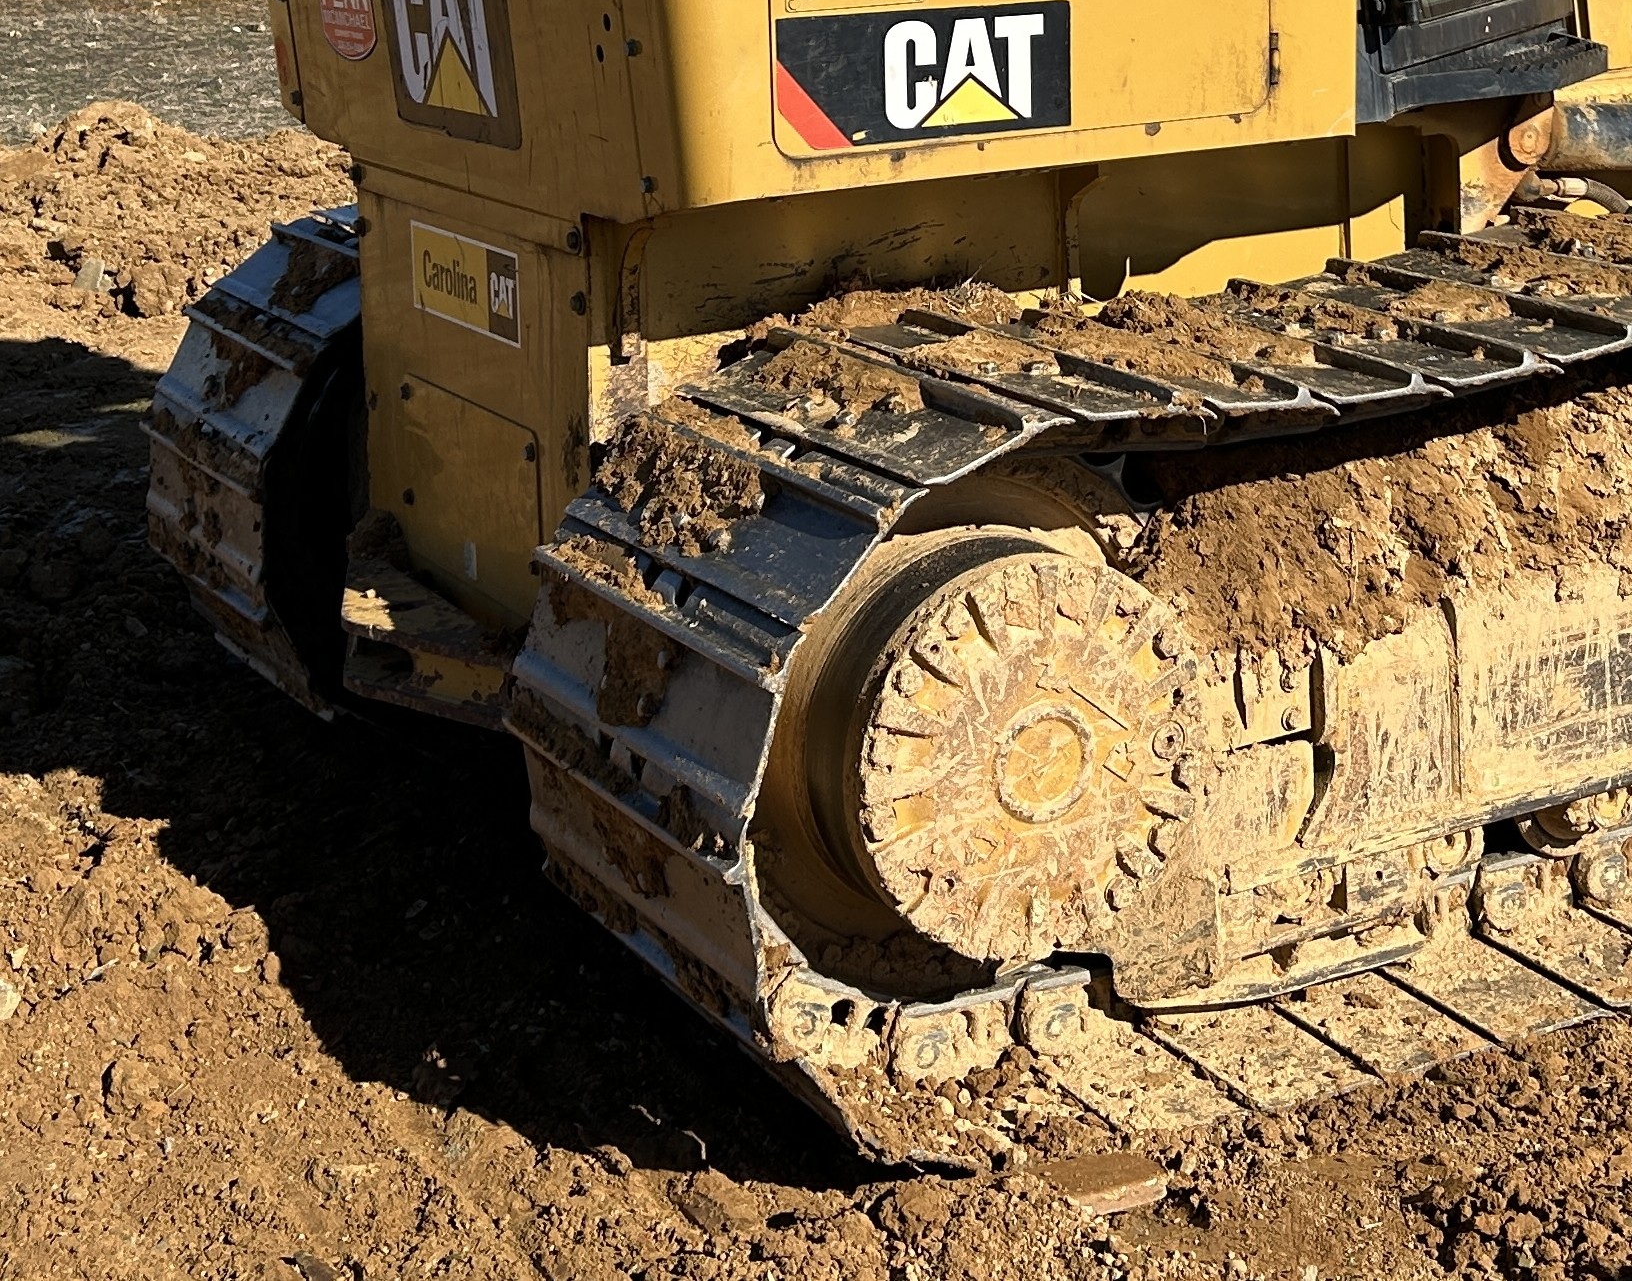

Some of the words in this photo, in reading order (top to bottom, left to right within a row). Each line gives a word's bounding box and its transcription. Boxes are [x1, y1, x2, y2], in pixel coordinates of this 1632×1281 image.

[884, 13, 1045, 129] CAT
[422, 249, 478, 305] Carolina
[489, 271, 516, 320] CAT
